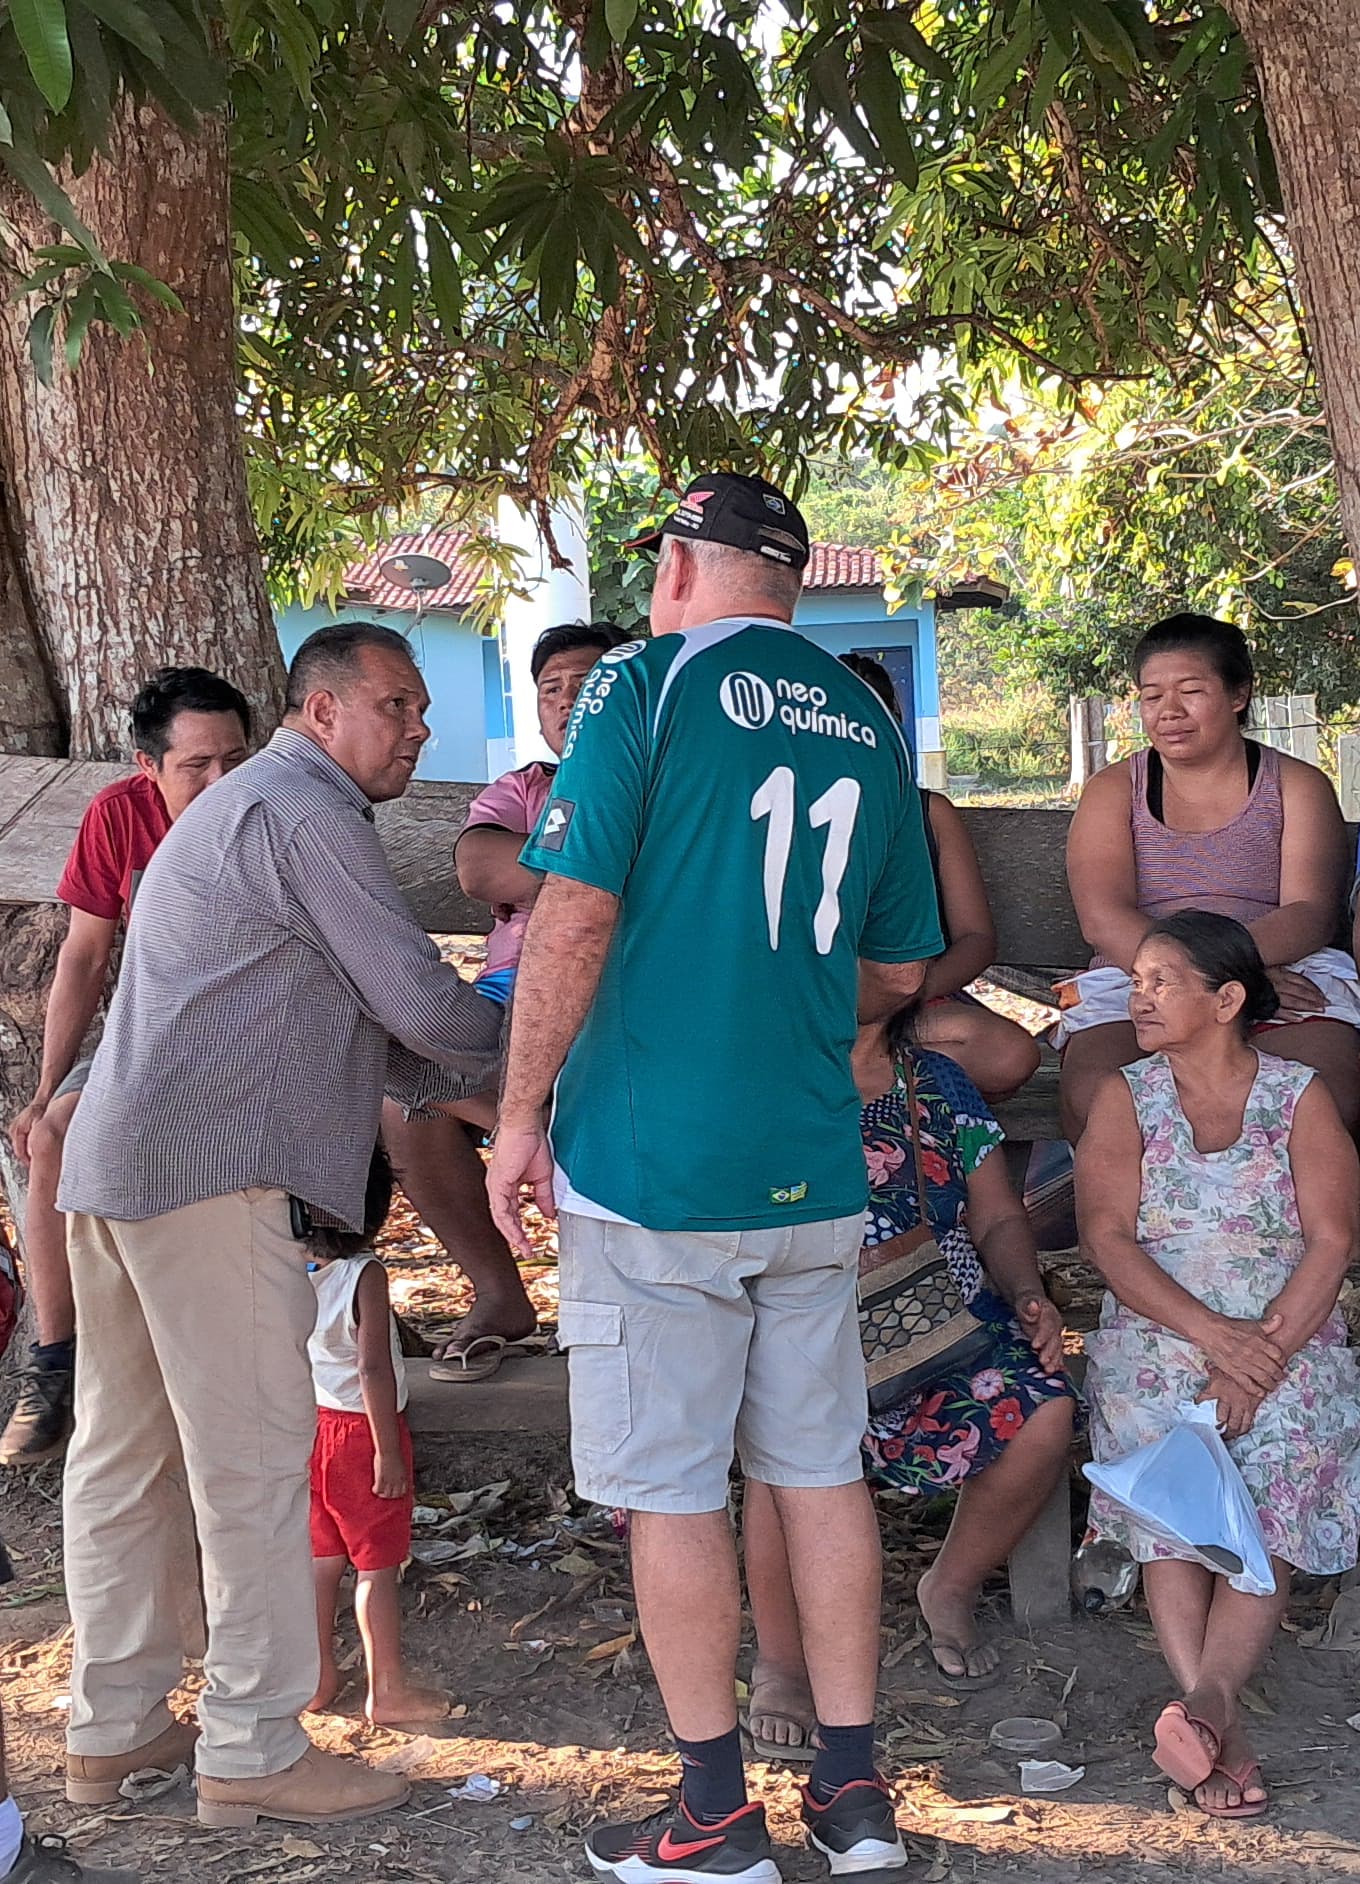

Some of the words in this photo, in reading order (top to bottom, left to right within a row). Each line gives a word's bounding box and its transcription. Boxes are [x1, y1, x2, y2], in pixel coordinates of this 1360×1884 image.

[589, 669, 618, 715] neo
[776, 678, 828, 707] neo
[779, 704, 877, 749] química
[750, 766, 861, 955] 11
